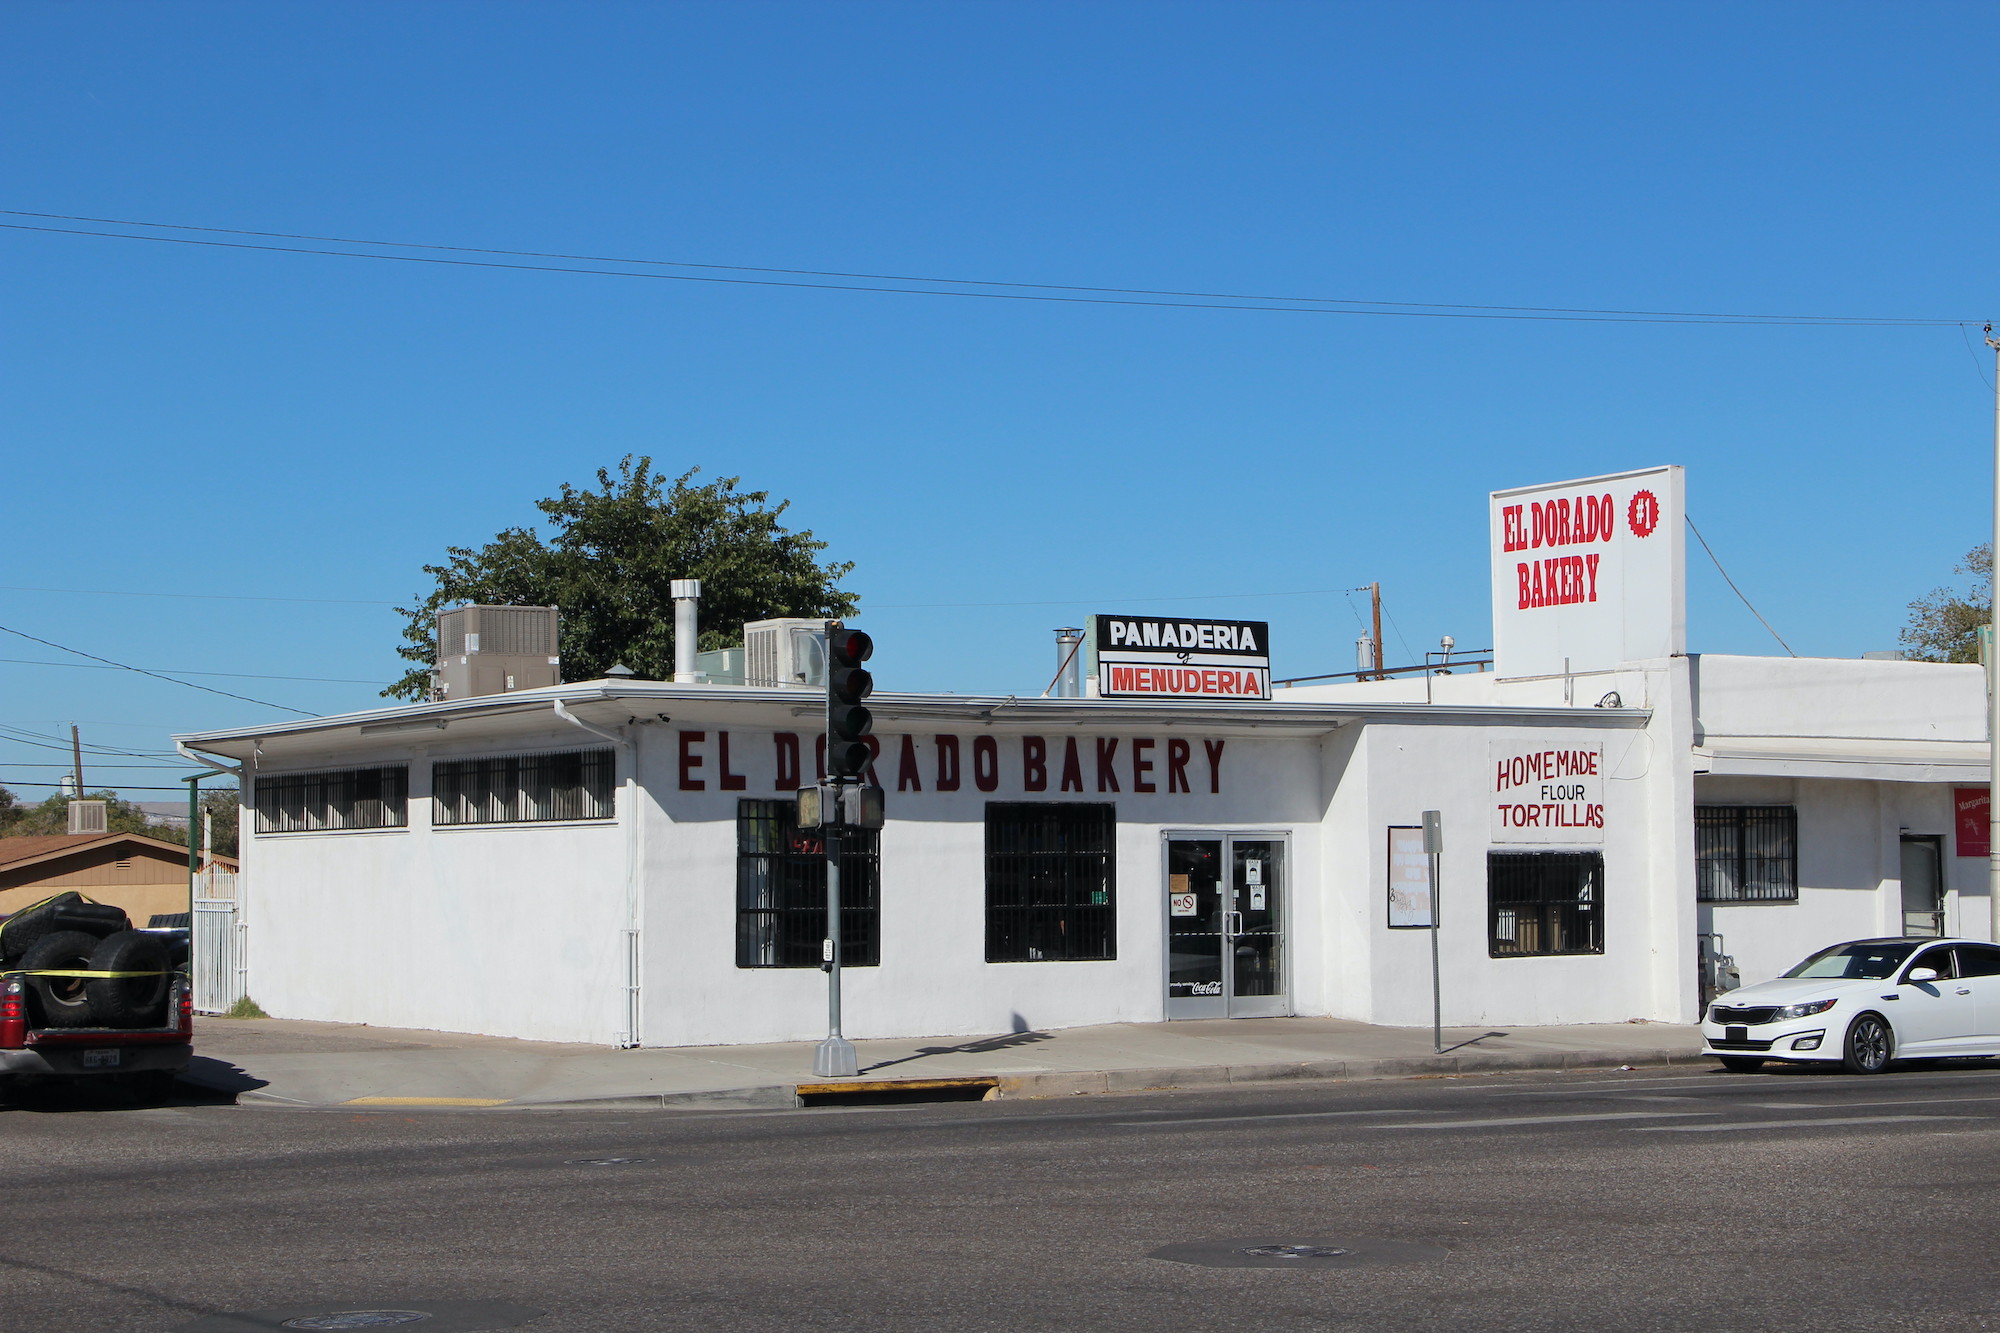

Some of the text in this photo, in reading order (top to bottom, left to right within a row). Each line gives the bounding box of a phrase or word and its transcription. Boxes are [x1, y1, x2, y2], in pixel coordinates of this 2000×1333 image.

[1503, 493, 1614, 553] EL DORADO
[1635, 498, 1651, 530] #1
[1517, 553, 1600, 610] BAKERY
[1109, 621, 1258, 651] PANADERIA
[1112, 667, 1260, 695] MENUDERIA
[679, 731, 746, 791] EL
[1023, 736, 1225, 794] BAKERY
[1497, 750, 1598, 792] HOMEMADE
[1541, 785, 1585, 800] FLOUR
[1498, 804, 1604, 828] TORTILLAS
